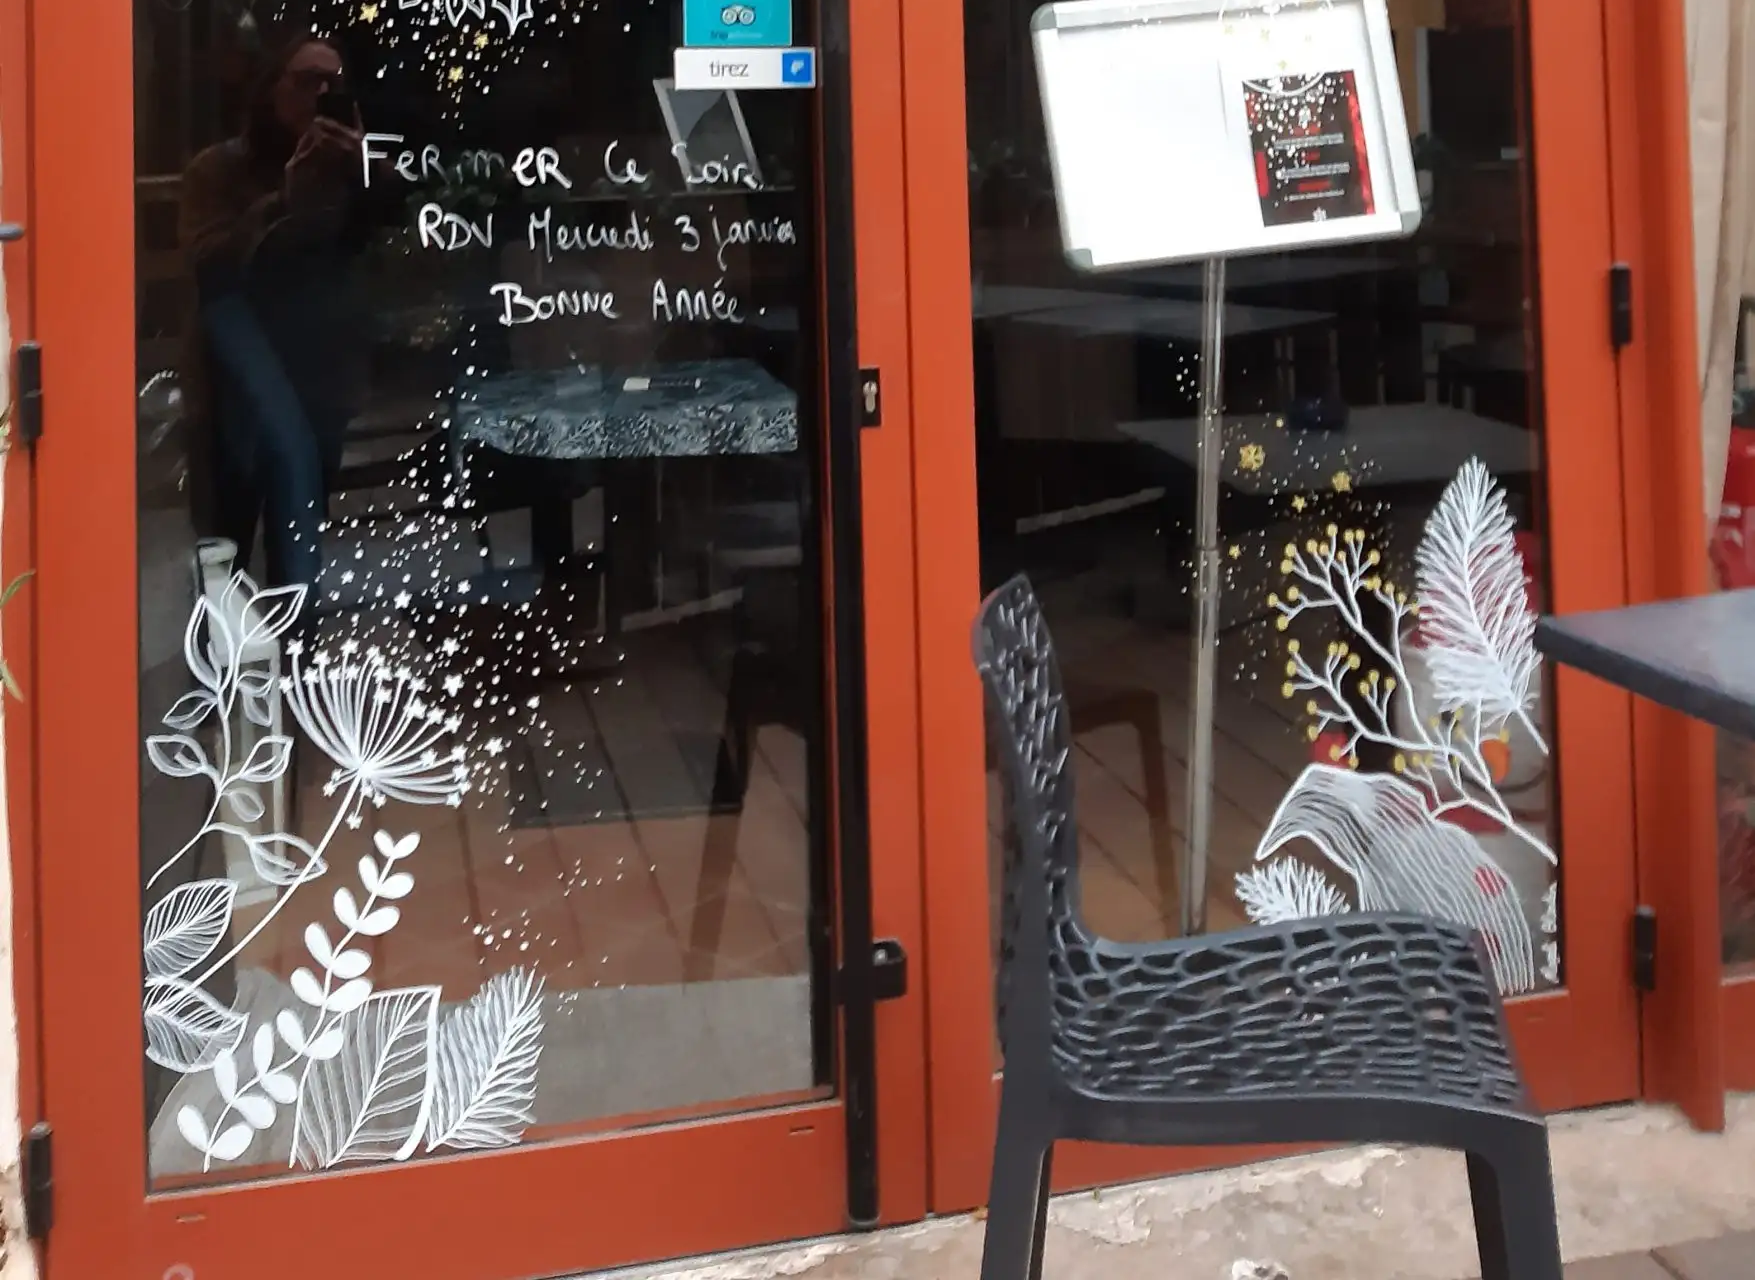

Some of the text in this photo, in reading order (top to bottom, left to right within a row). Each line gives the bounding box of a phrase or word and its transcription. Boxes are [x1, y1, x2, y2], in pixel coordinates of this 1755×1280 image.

[709, 60, 749, 78] tirez
[418, 202, 493, 251] RDV
[674, 214, 700, 251] 3
